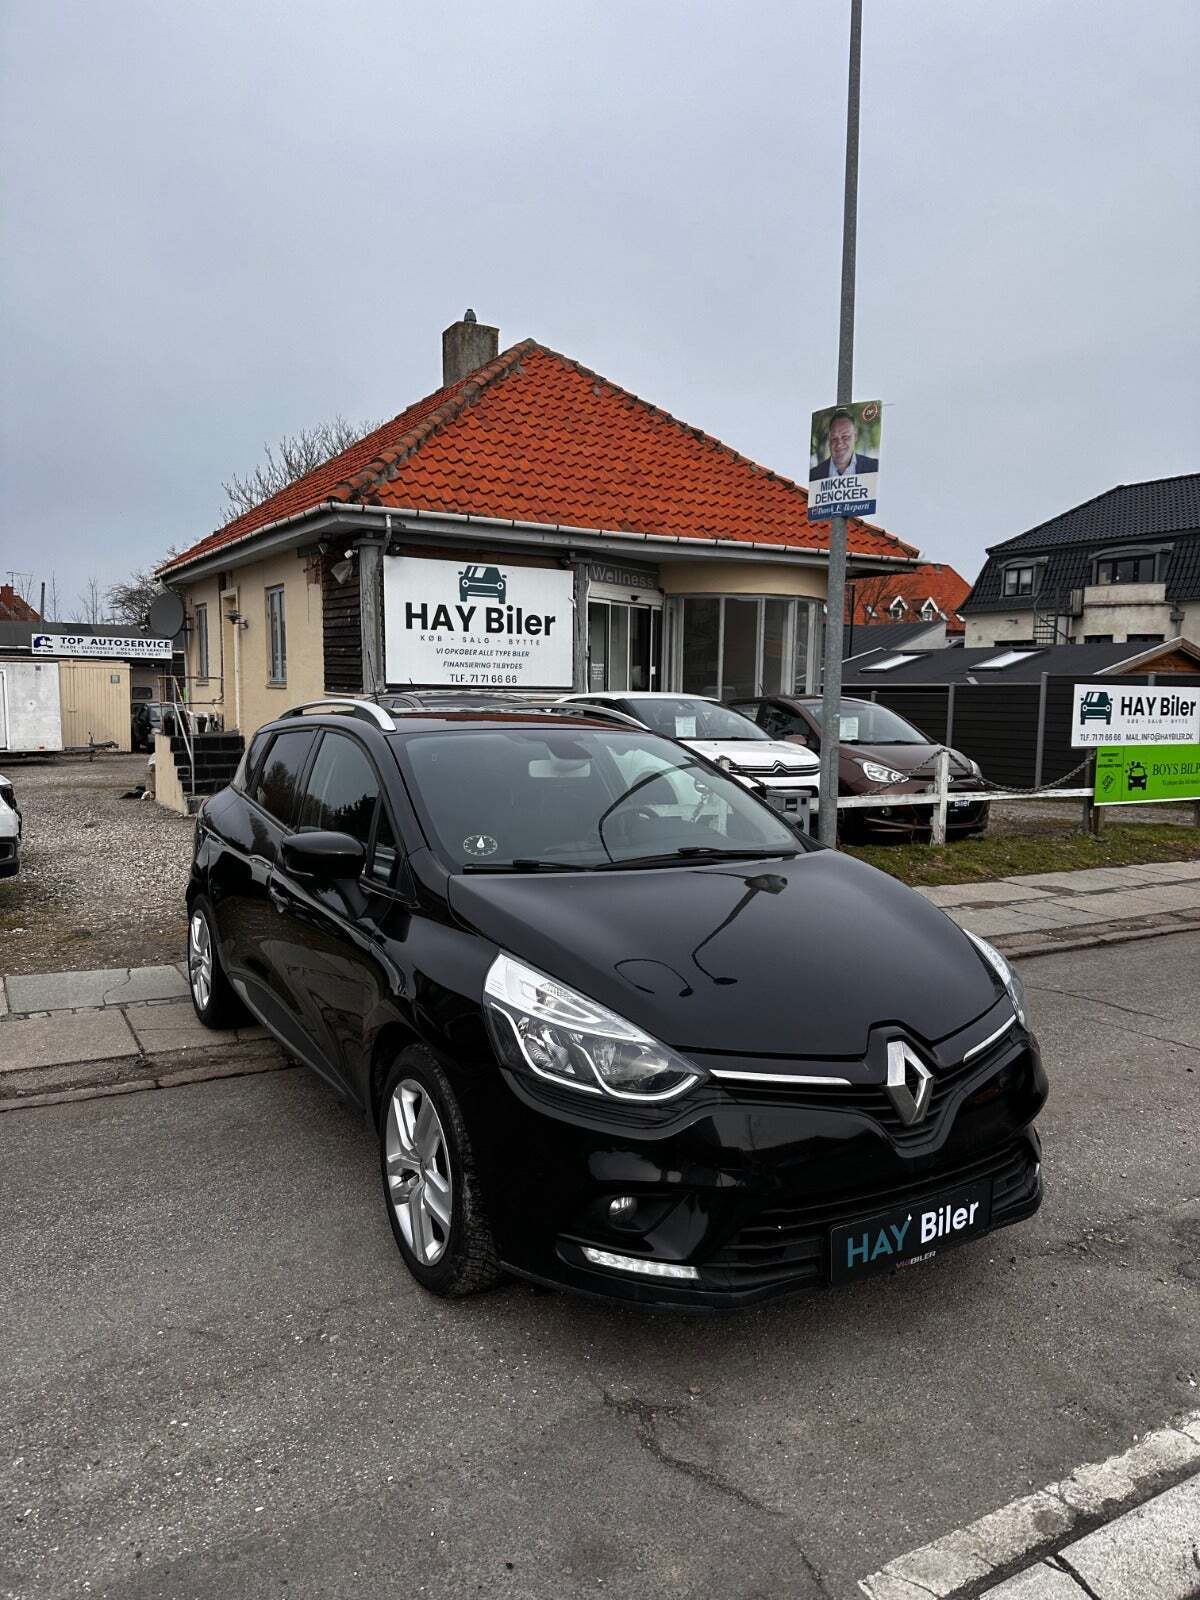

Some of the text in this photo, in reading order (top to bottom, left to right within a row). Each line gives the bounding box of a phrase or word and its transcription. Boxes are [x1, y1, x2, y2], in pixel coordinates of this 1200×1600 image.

[821, 477, 862, 491] MIKKEL
[816, 488, 868, 504] DENCKER
[592, 566, 654, 588] Wellness
[405, 601, 556, 636] HAY Biler
[60, 636, 171, 649] TOP AUTOSERVICE
[420, 634, 540, 646] KØB SALG BYTTE
[443, 661, 523, 670] FINANSIERING TILBYDES
[450, 673, 518, 684] TLF. 71 71 66 66
[1120, 694, 1197, 717] HAY Biler
[1152, 763, 1178, 775] BOYS
[847, 1200, 979, 1268] HAY Biler
